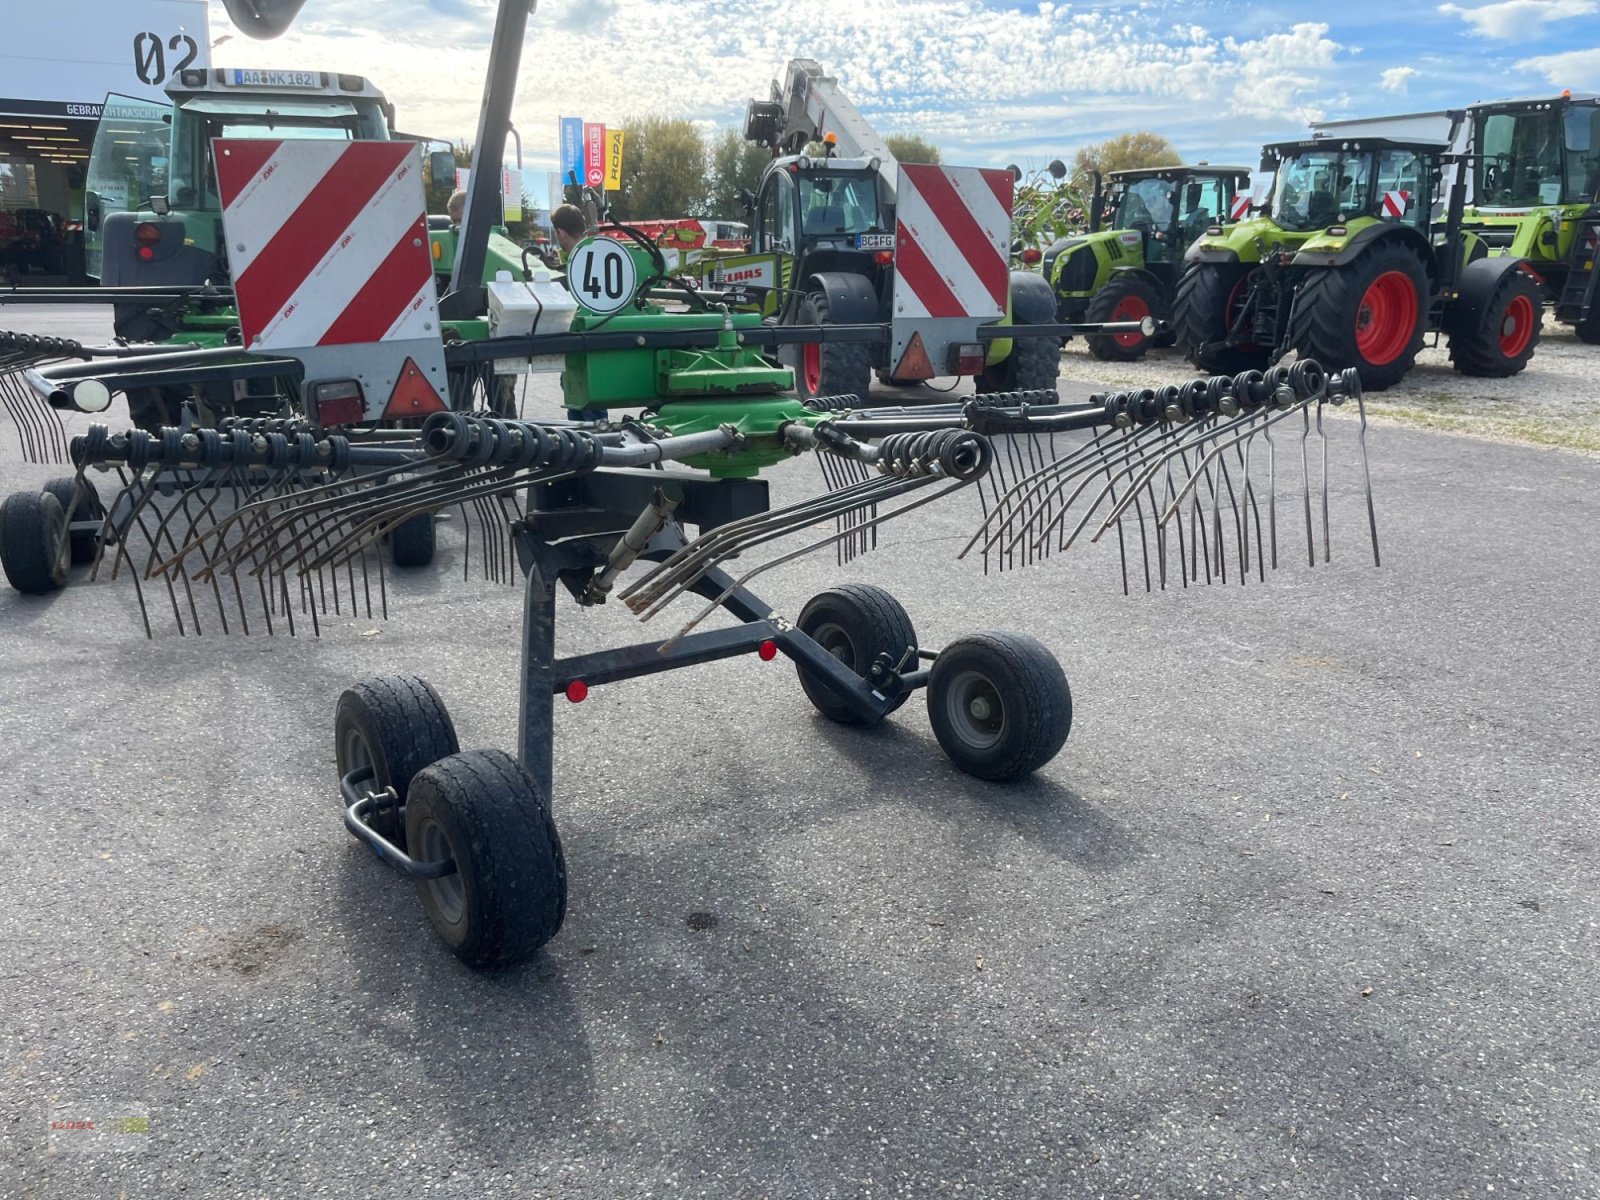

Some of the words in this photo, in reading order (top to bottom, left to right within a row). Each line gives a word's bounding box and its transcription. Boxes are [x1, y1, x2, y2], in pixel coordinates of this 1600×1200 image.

[133, 31, 198, 86] 02
[244, 71, 260, 84] AA
[268, 72, 287, 85] WK
[288, 73, 312, 86] 182
[591, 126, 600, 167] SILOKING
[611, 132, 623, 181] ROPA
[861, 235, 874, 246] BC
[879, 235, 892, 246] FG
[582, 250, 624, 300] 40
